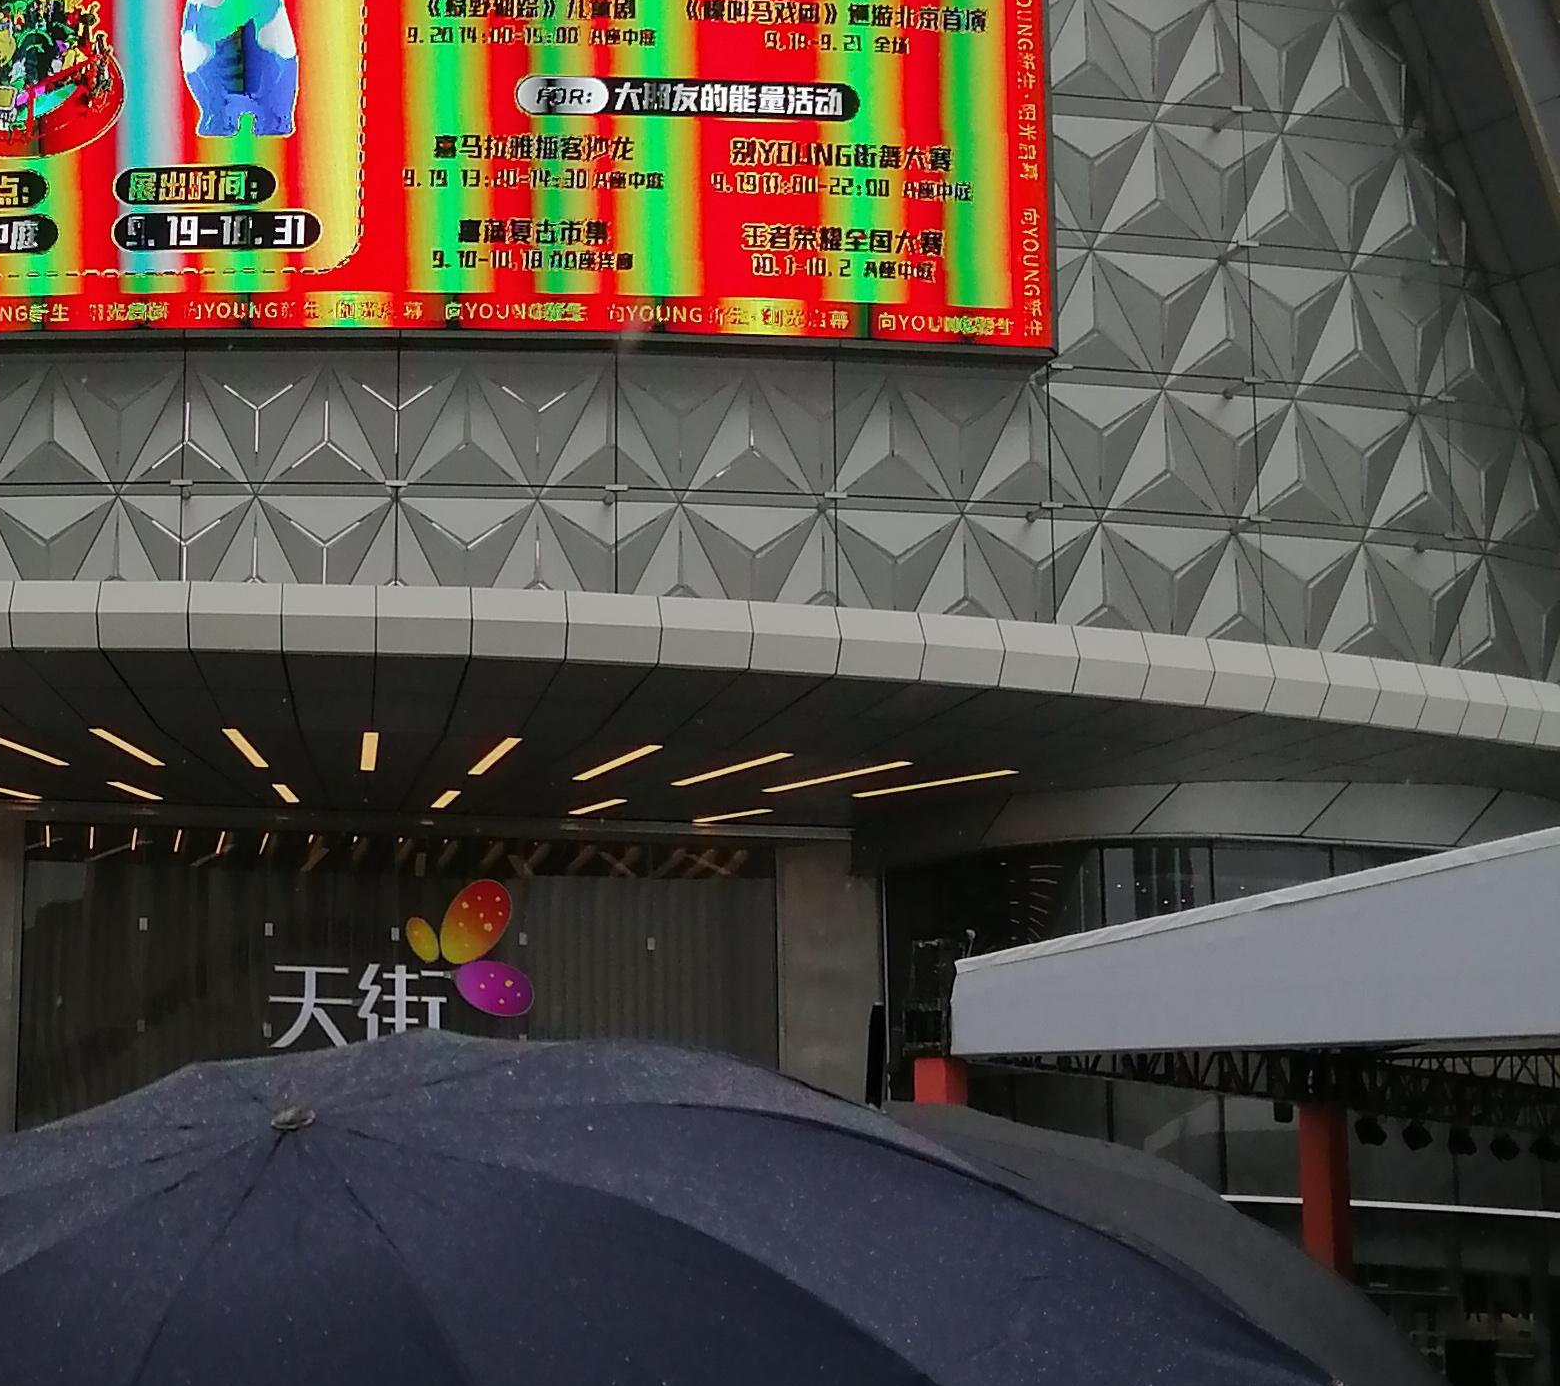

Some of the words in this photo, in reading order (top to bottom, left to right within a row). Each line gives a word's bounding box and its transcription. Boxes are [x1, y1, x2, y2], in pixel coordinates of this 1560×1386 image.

[614, 81, 843, 117] 大朋友的能量活动
[740, 222, 945, 258] 王者荣耀全国大赛
[267, 963, 448, 1048] 天街
